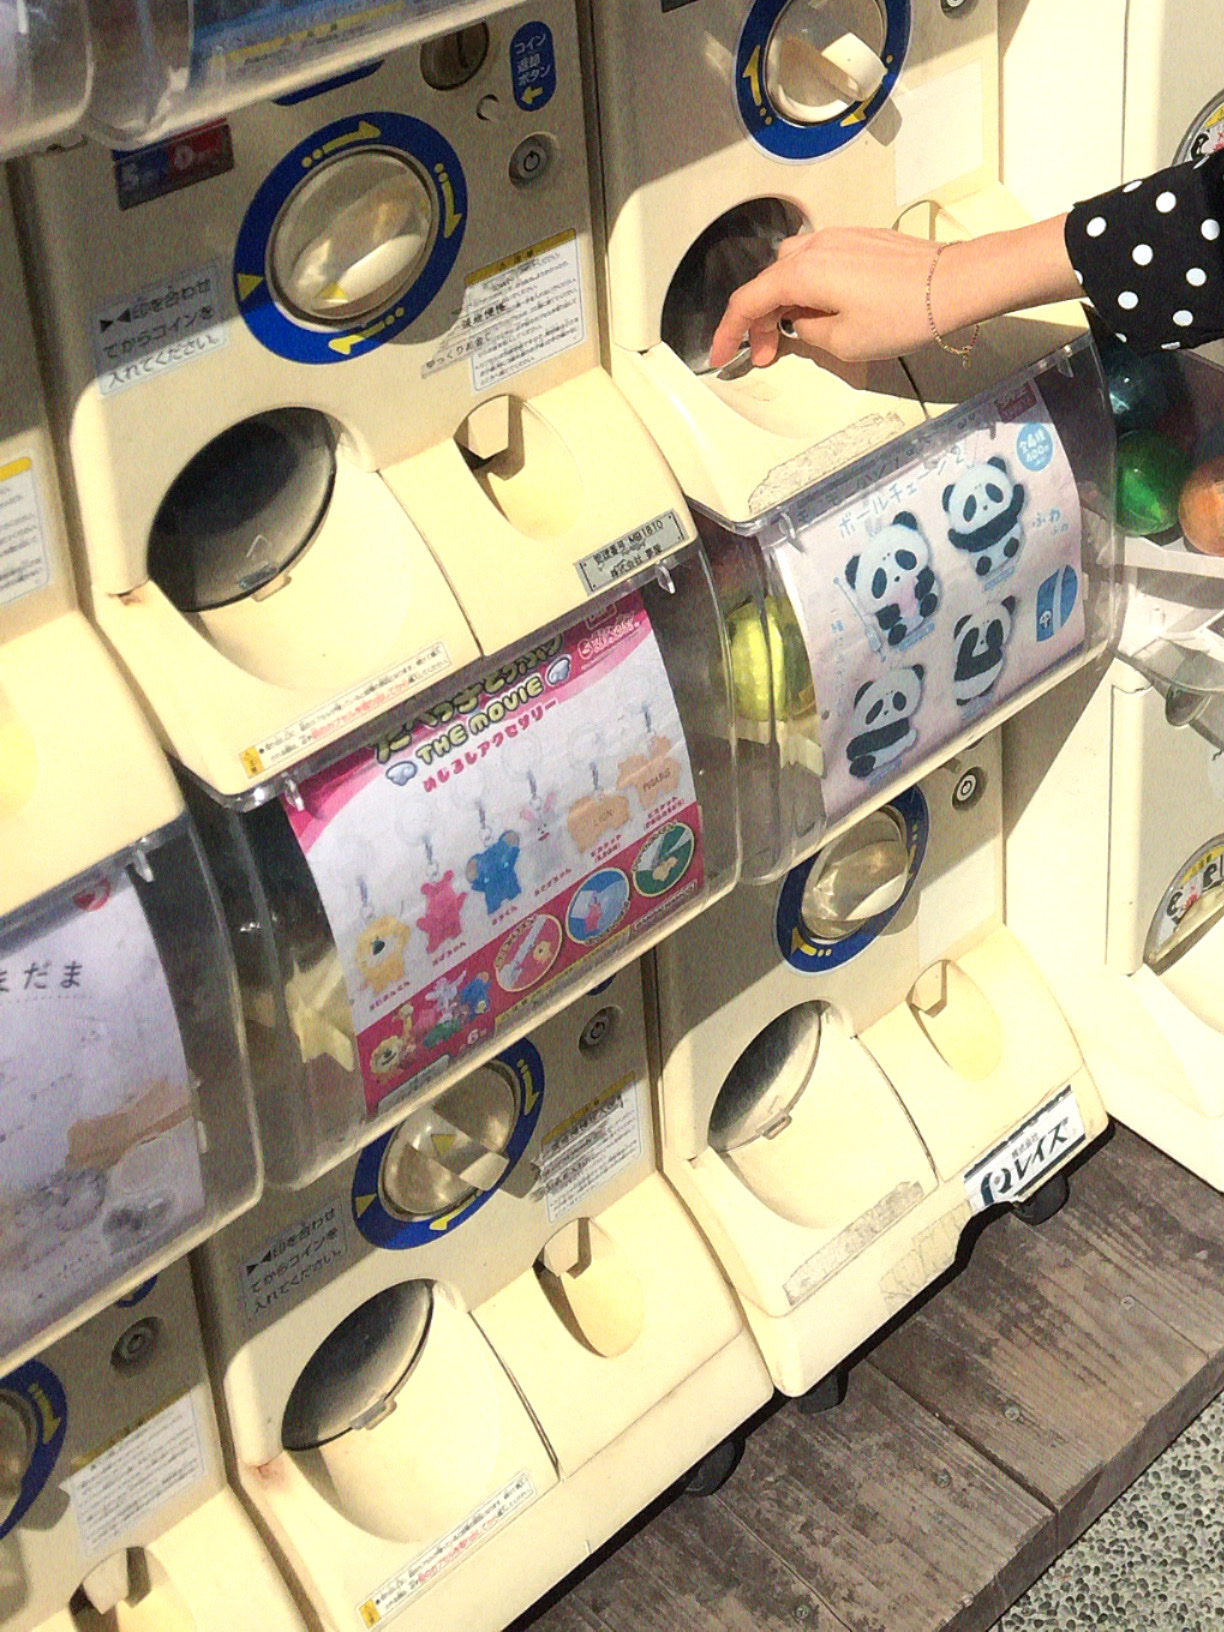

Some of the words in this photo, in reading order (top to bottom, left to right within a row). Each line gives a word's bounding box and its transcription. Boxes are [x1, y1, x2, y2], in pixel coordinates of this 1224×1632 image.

[514, 32, 546, 54] コイン
[517, 65, 552, 87] ボタン
[416, 724, 469, 765] THE
[468, 675, 544, 736] MOVIE
[423, 699, 558, 793] めじるしアクセサリー
